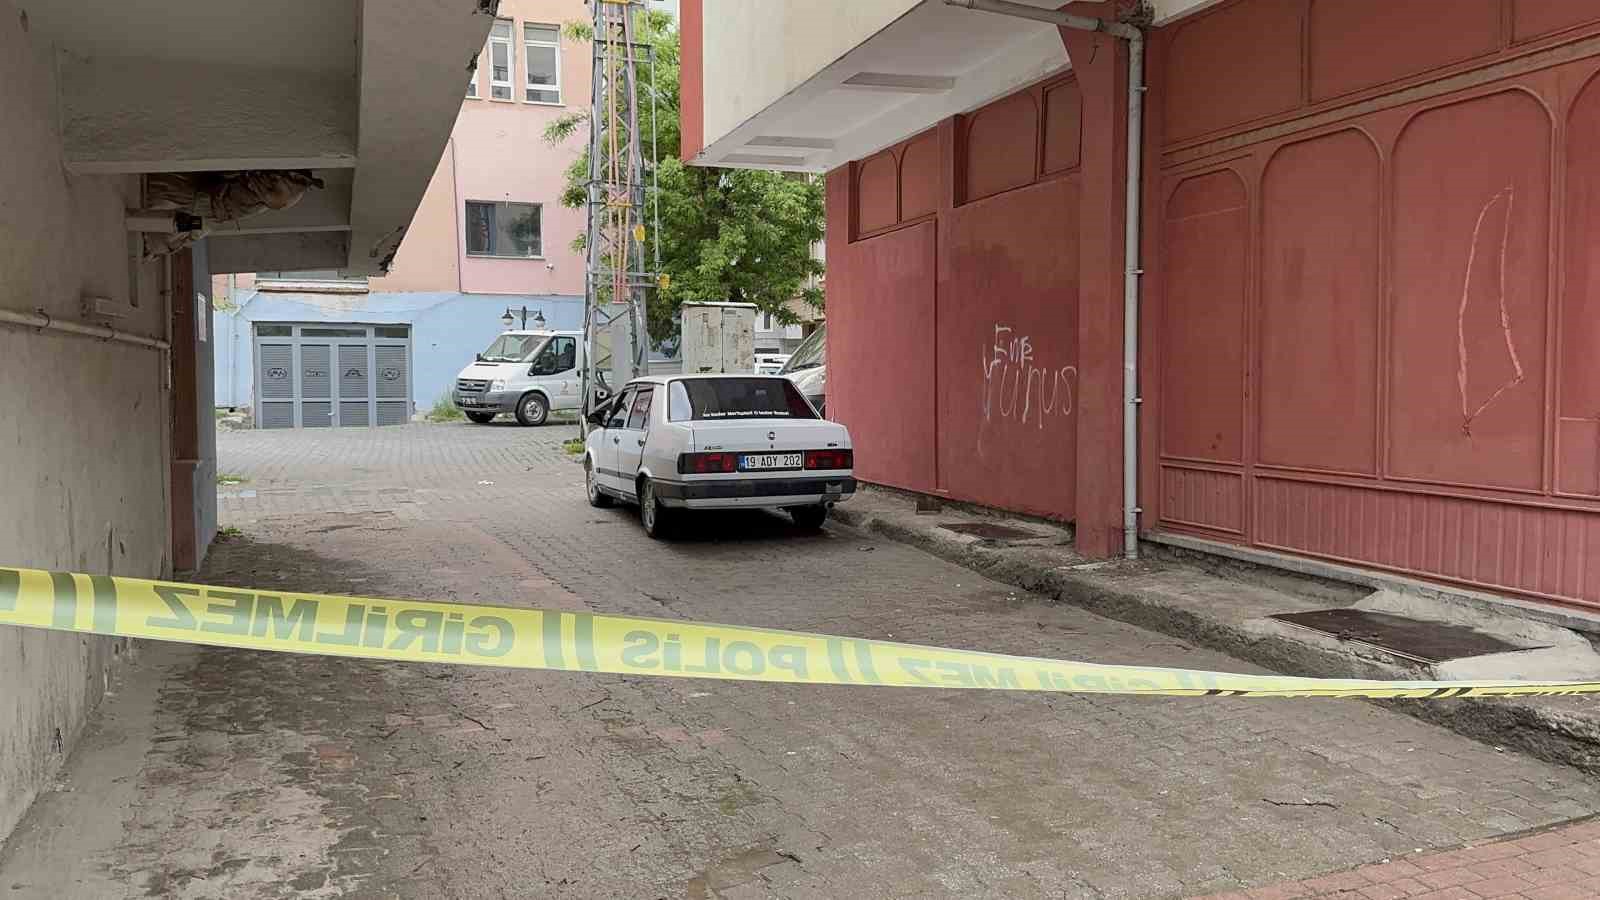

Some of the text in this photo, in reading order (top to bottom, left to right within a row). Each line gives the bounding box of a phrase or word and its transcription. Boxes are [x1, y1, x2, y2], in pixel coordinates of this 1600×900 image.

[745, 456, 756, 467] 19
[761, 455, 778, 467] ADY
[783, 455, 801, 466] 202
